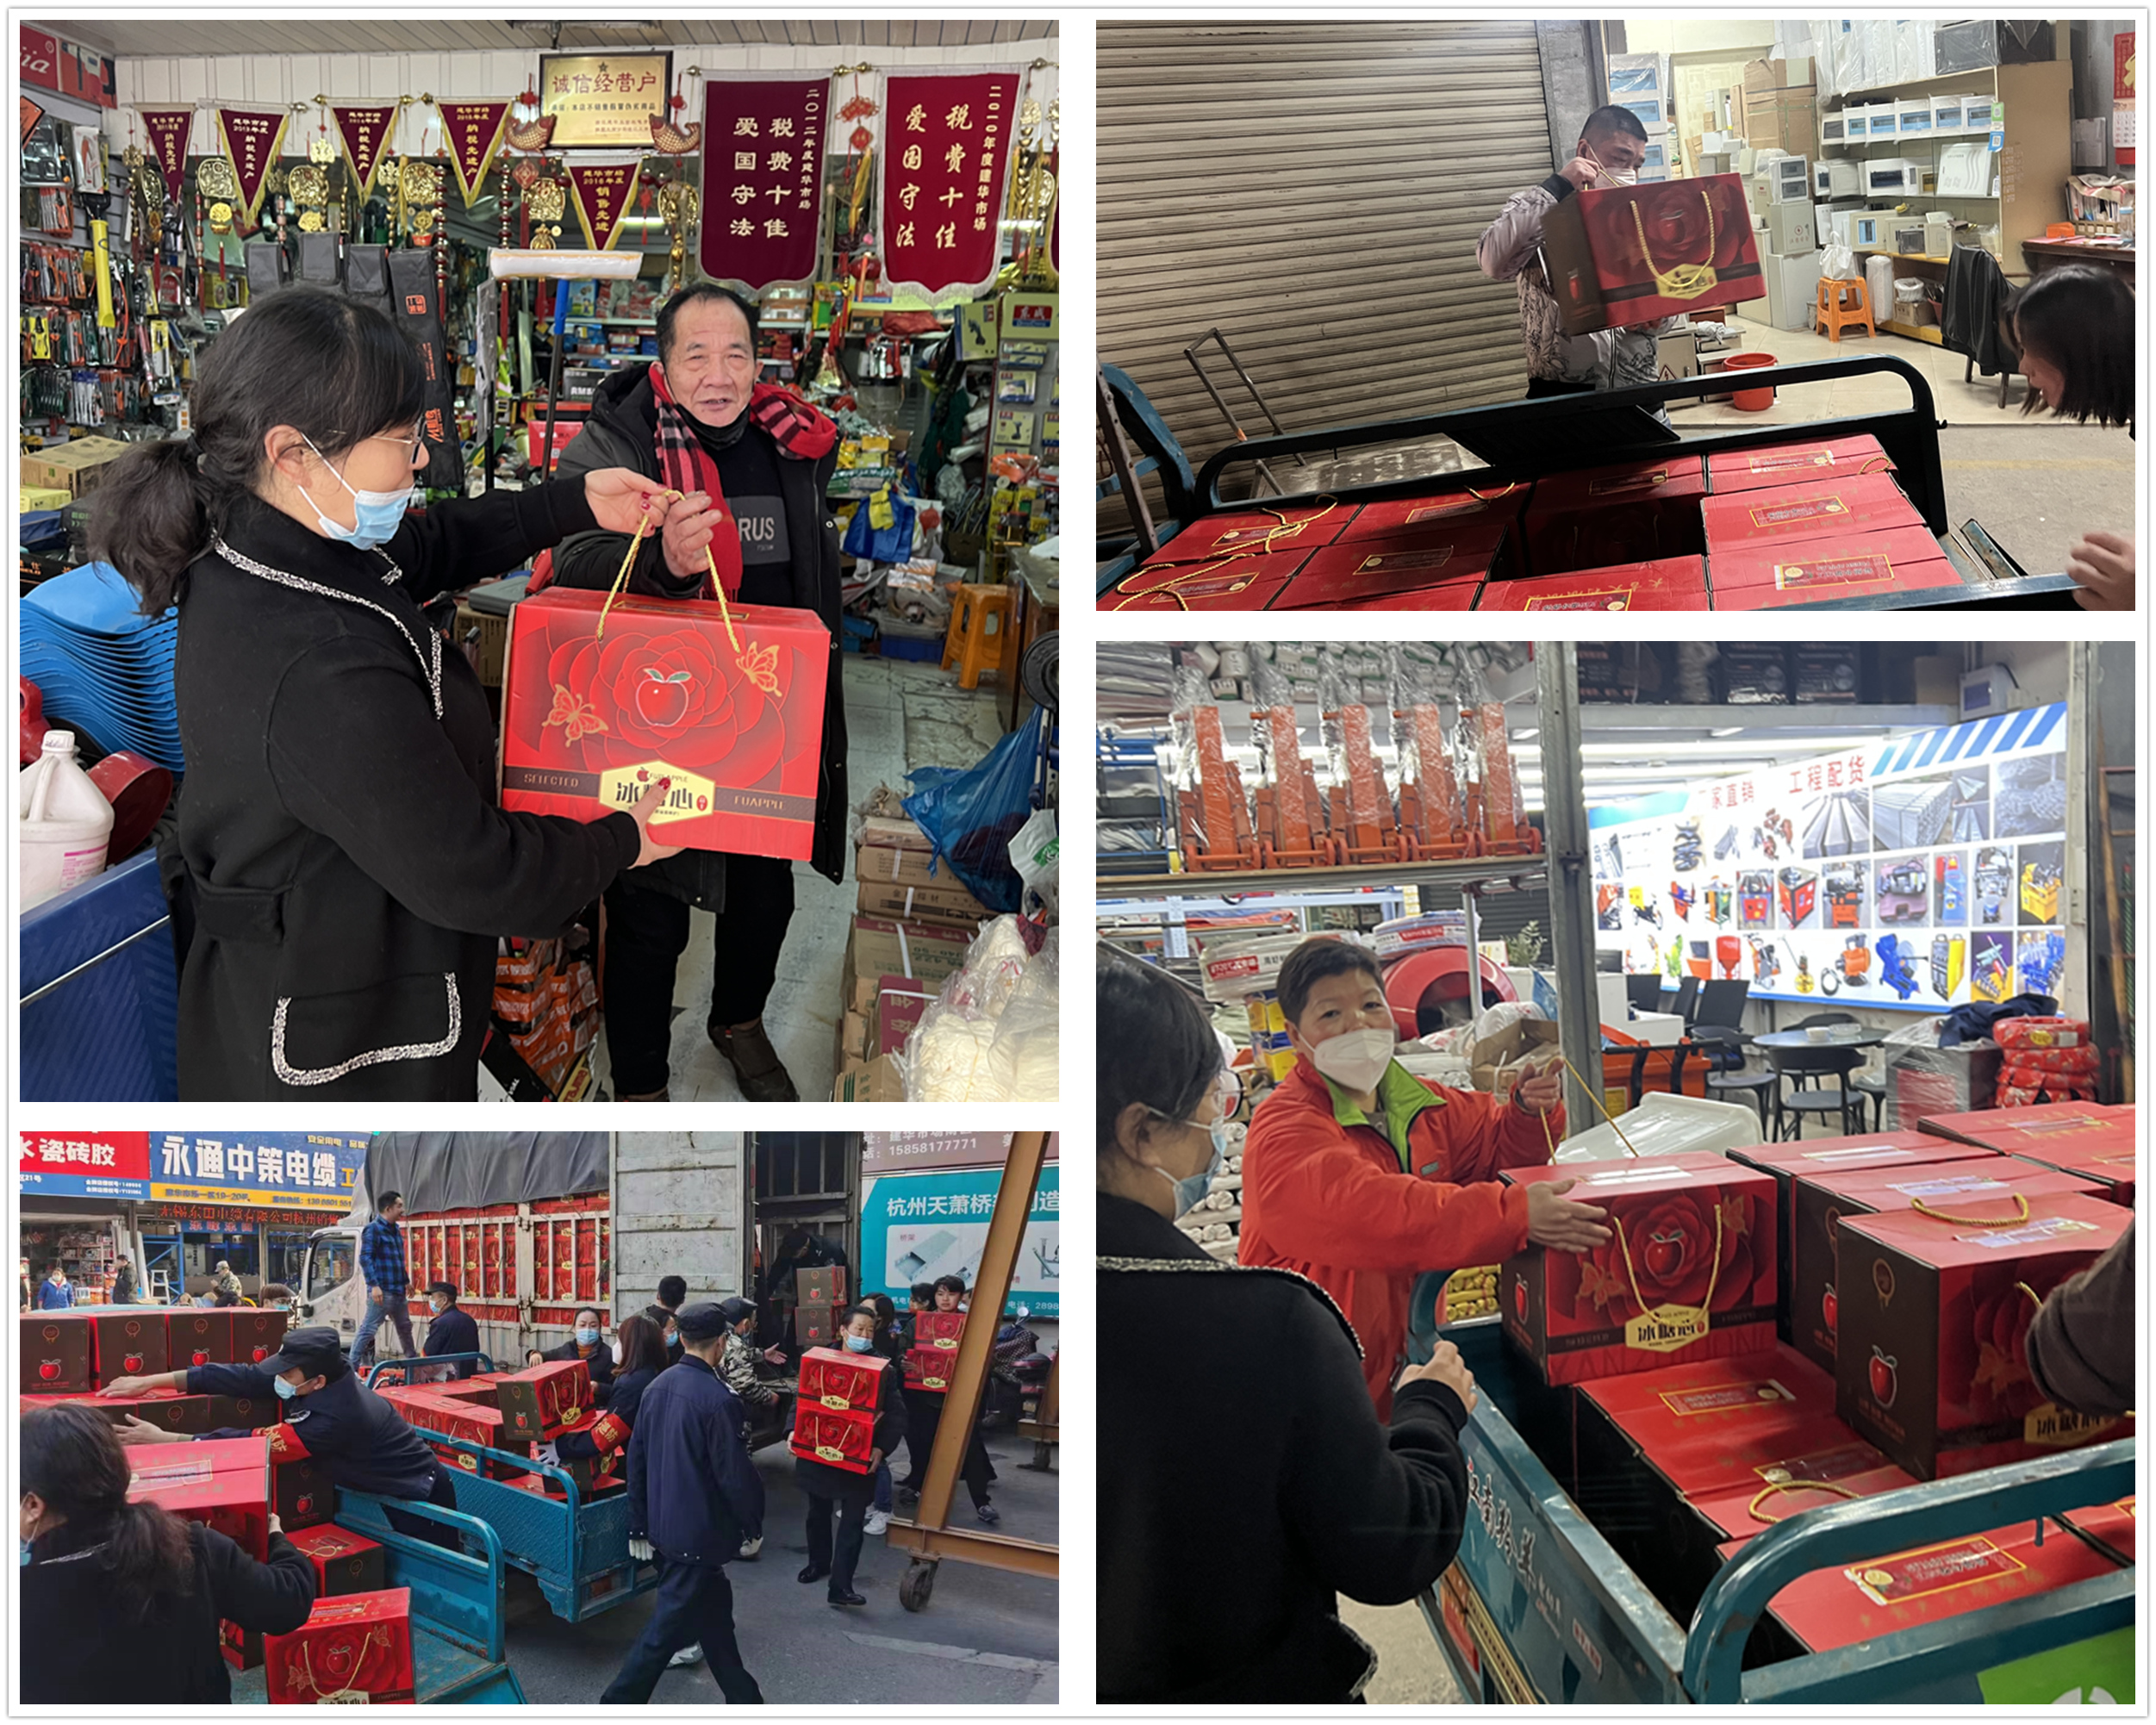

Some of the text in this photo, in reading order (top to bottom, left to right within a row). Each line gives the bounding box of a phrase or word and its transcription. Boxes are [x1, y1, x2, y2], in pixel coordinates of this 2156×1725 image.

[20, 47, 50, 74] ia
[552, 72, 657, 94] 诚信经营户
[729, 117, 760, 237] 爱国守法
[763, 117, 795, 239] 税费十佳
[895, 103, 927, 248] 爱国守法
[935, 103, 973, 249] 税费十佳
[524, 773, 579, 788] SELECTED
[1789, 755, 1865, 794] 工程配货
[734, 795, 784, 809] FUAPPLE
[39, 1138, 115, 1167] 瓷砖胶
[162, 1135, 336, 1187] 永通中策电缆
[889, 1138, 976, 1156] 15858177771
